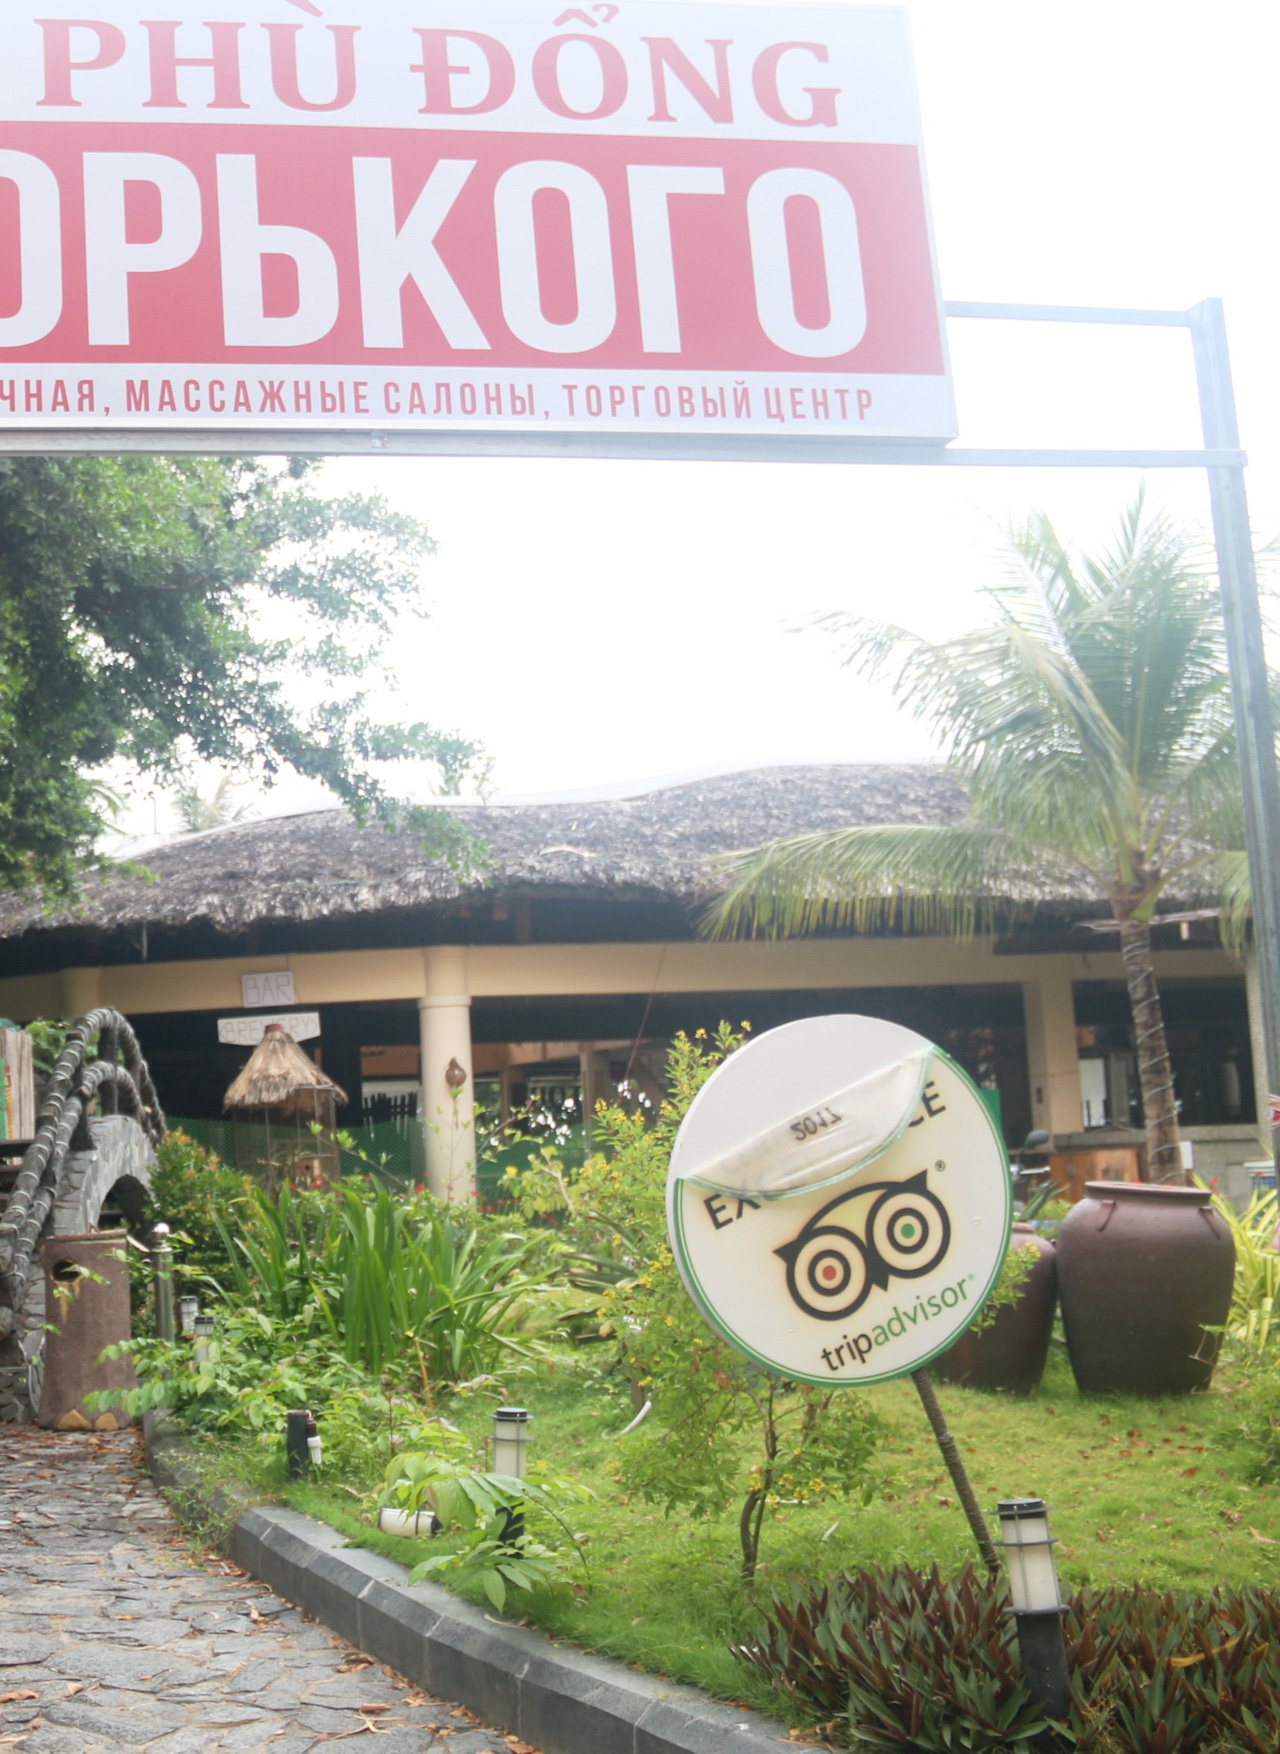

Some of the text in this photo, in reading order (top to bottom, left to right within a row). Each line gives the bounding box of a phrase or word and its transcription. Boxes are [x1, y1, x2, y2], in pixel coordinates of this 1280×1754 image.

[35, 0, 362, 112] PHÙ
[409, 4, 841, 128] ĐỔNG
[125, 379, 371, 414] МАССАЖНЫЕ
[383, 382, 550, 420] САЛОНЫ,
[561, 380, 751, 420] ТОРГОВЫЙ
[764, 387, 873, 422] ЦЕНТР
[245, 975, 291, 1004] BAR
[821, 1276, 970, 1372] tripadvisor
